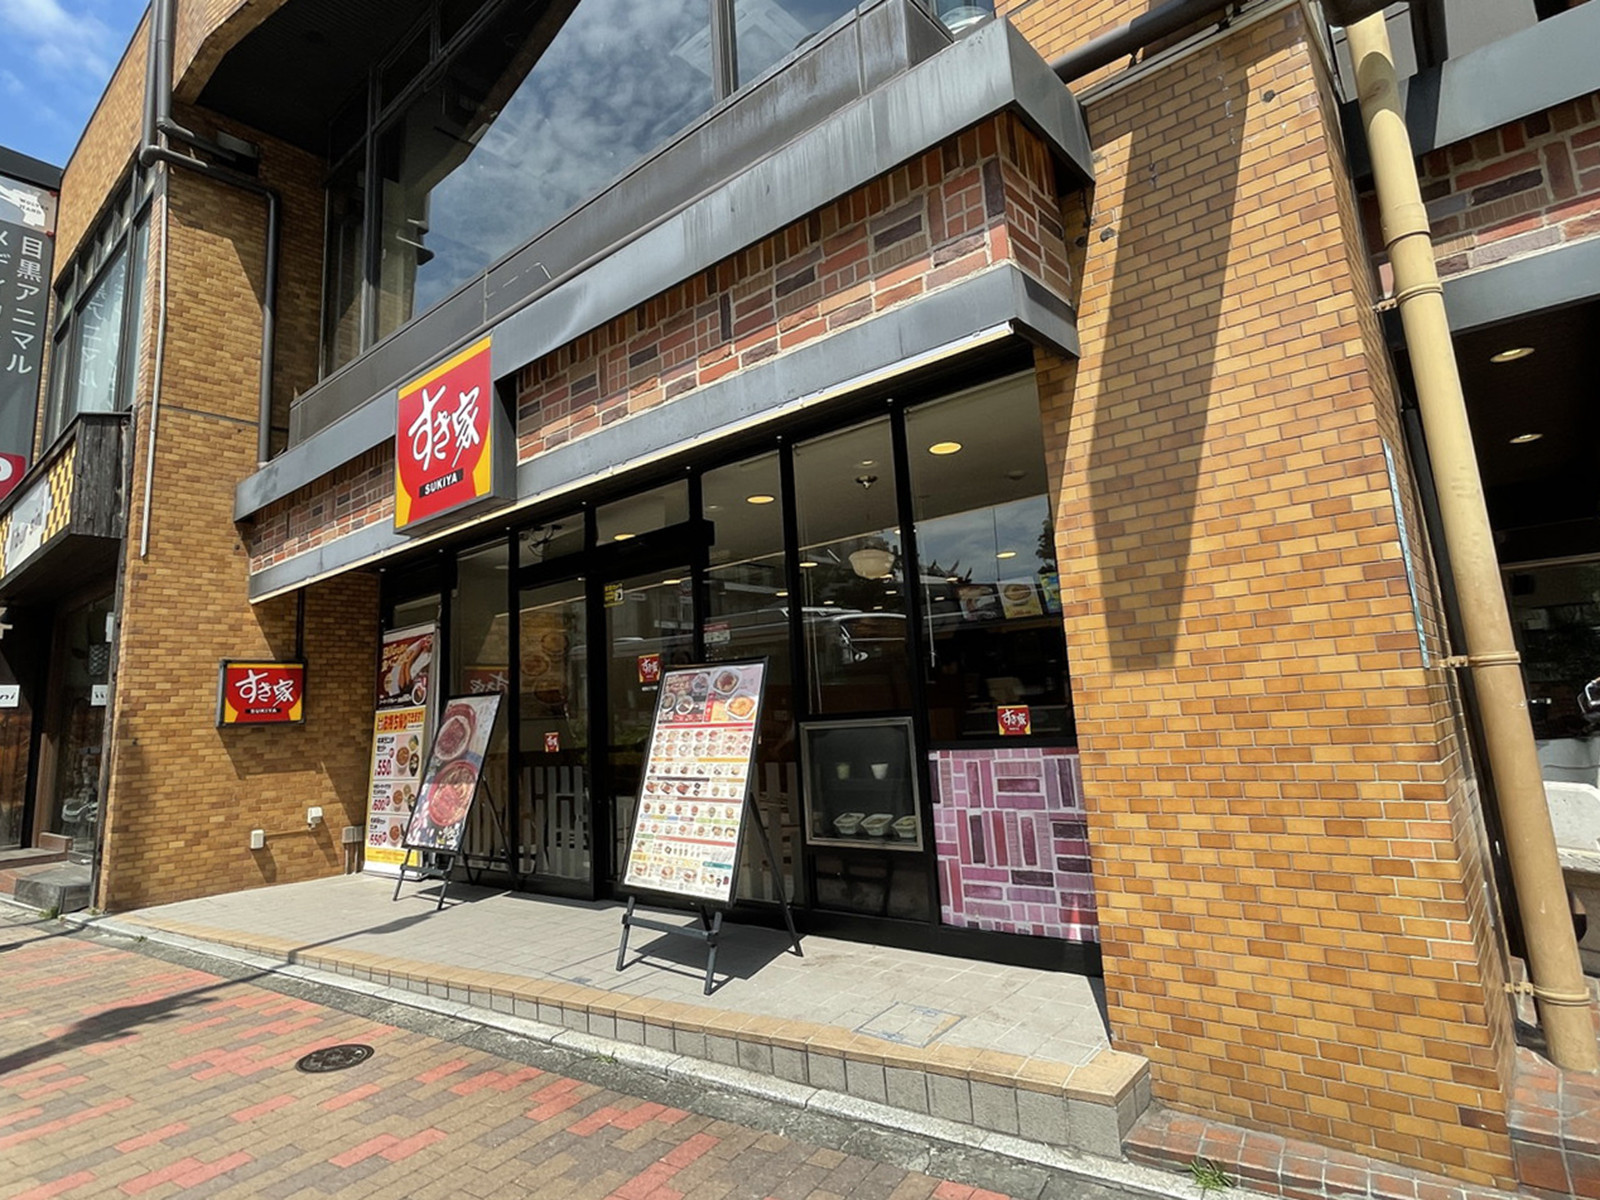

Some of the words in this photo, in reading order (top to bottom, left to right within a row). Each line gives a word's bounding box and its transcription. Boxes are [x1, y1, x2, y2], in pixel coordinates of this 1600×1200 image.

[6, 236, 43, 374] 目黒アニマル
[407, 384, 481, 472] すき家
[424, 472, 458, 496] SUKIYA
[235, 669, 294, 707] すき家
[1000, 708, 1027, 727] すき家
